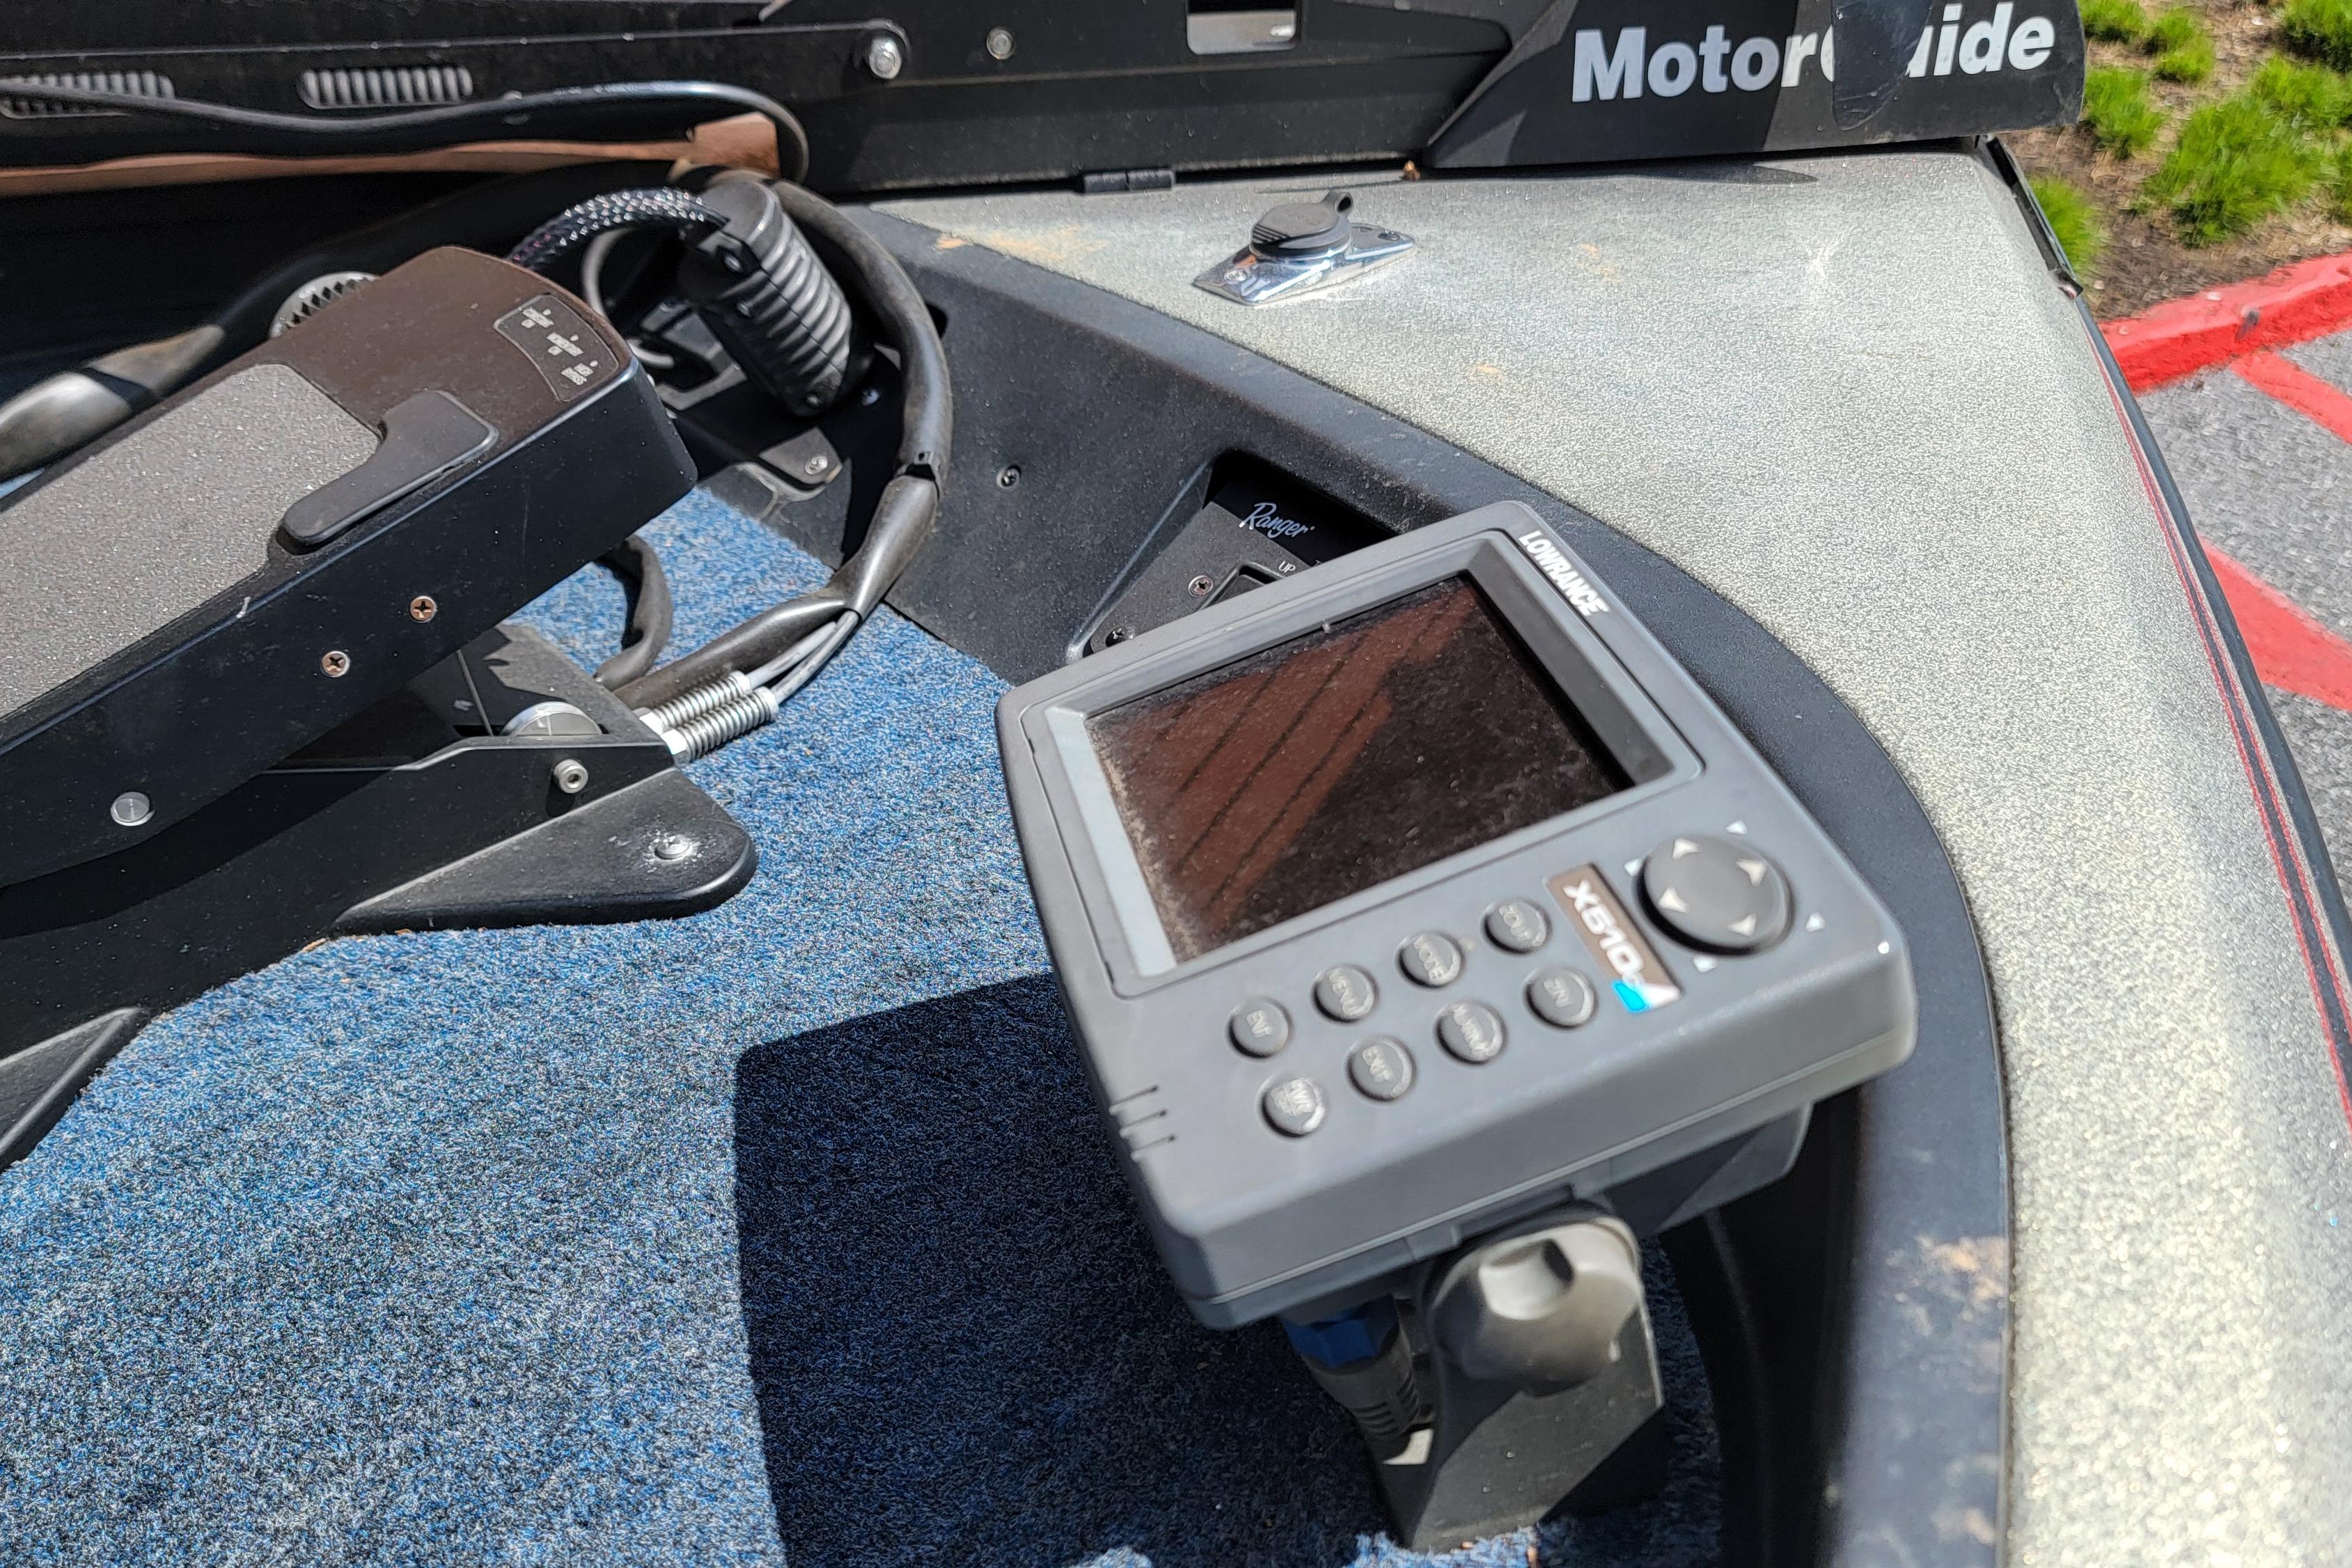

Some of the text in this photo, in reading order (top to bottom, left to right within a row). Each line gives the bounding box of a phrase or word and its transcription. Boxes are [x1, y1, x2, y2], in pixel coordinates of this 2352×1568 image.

[1572, 1, 2056, 102] Motoride
[1239, 502, 1309, 538] Ranger
[1278, 560, 1296, 573] UP
[1519, 530, 1608, 617] LOWRANCE
